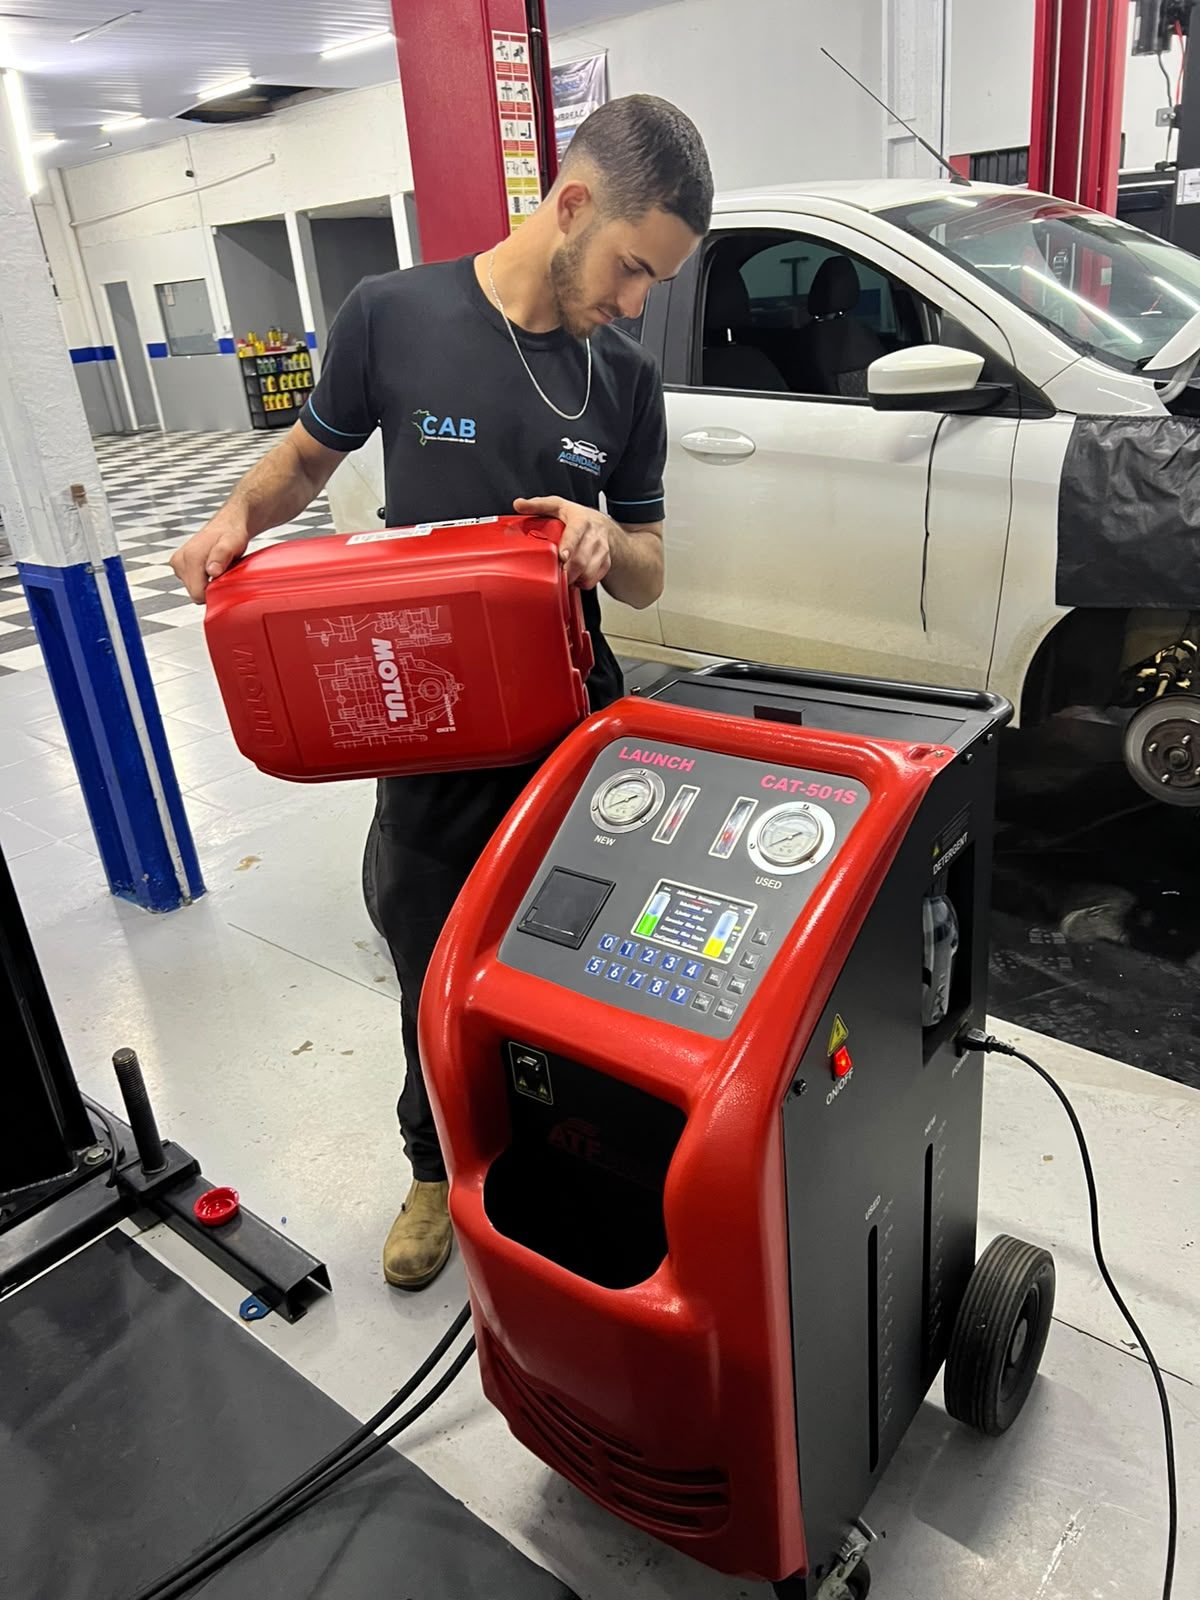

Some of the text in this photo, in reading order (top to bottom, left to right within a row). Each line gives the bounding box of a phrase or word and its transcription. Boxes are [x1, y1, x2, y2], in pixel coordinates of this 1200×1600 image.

[422, 415, 476, 438] CAB
[371, 637, 409, 722] MOTUL
[617, 746, 696, 772] LAUNCH
[760, 774, 859, 805] CAT-501S
[593, 834, 616, 847] NEW
[932, 831, 968, 876] DETERGENT
[755, 876, 783, 890] USED
[603, 936, 696, 977] 0 1 2 3 4
[590, 959, 686, 1000] 5 6 7 8 9
[826, 1066, 855, 1105] ON/OFF
